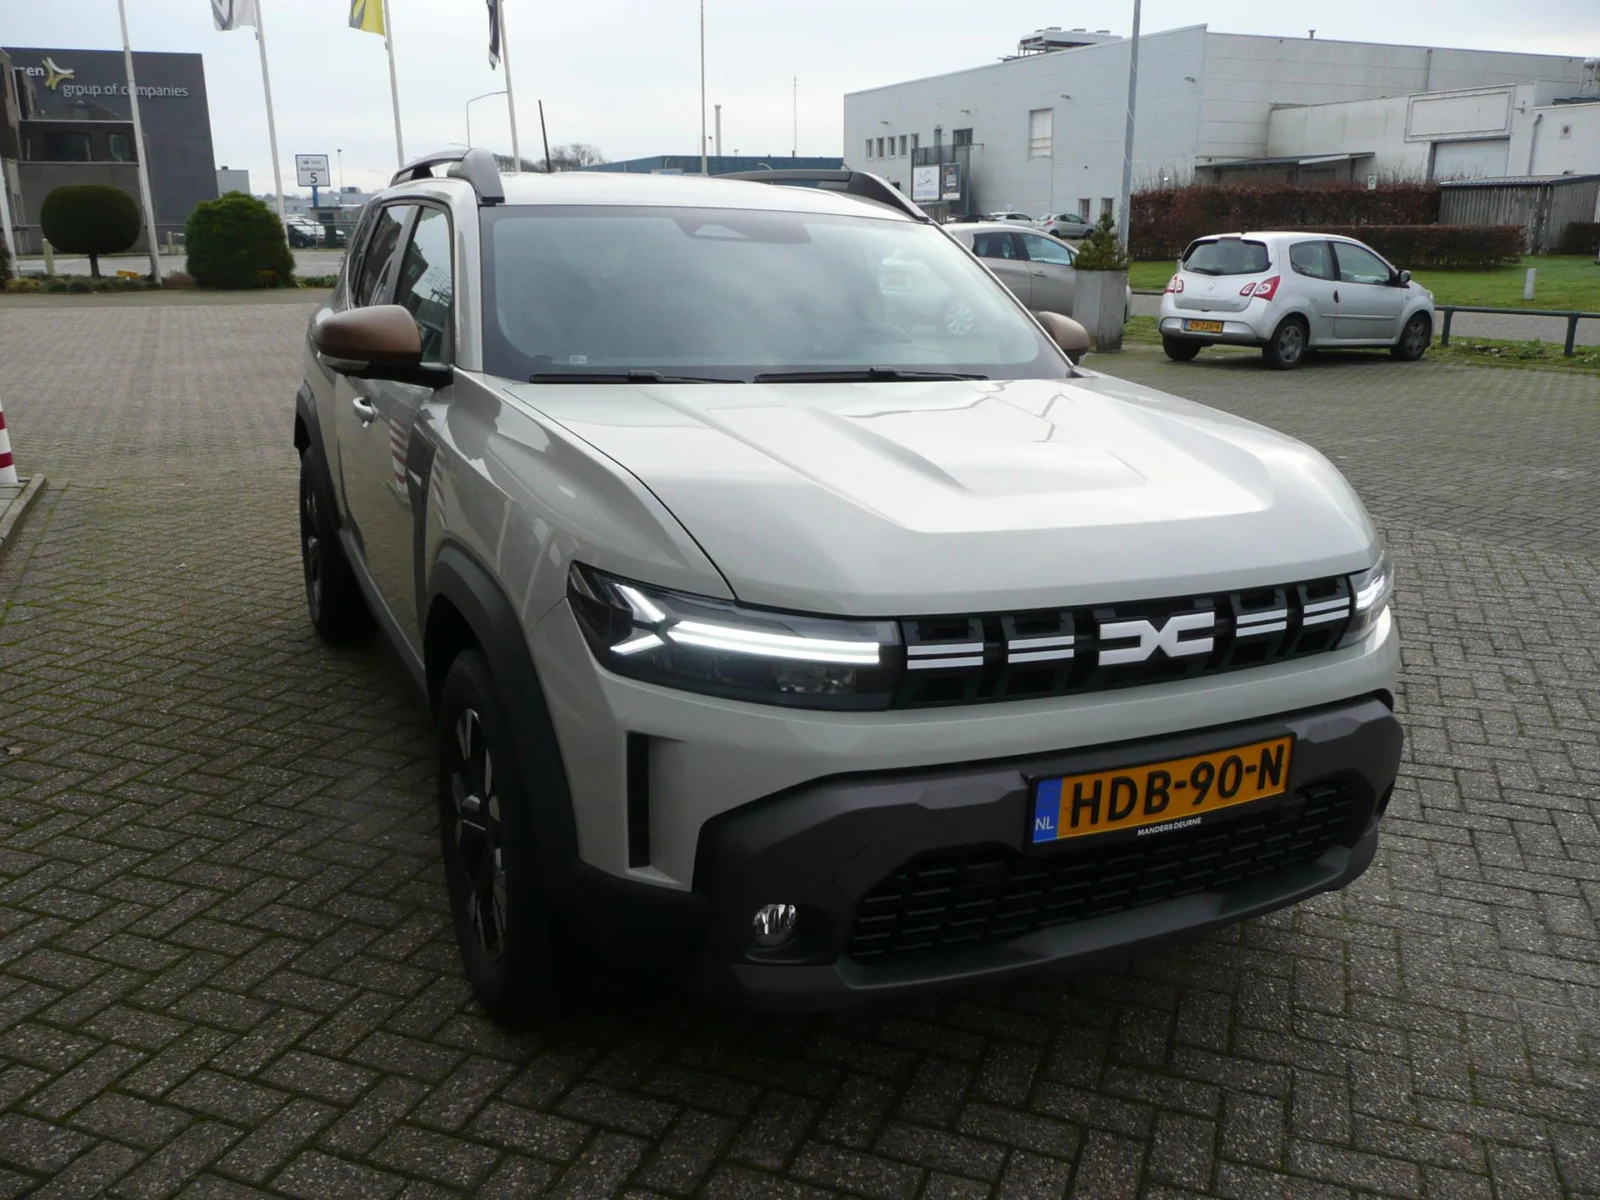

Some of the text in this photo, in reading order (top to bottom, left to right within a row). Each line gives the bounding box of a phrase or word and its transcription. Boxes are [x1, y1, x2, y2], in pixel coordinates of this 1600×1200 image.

[63, 83, 188, 99] group of cmpanies
[310, 172, 318, 184] 5
[1070, 744, 1285, 828] HDB-90-N
[1034, 816, 1055, 831] NL
[1137, 817, 1202, 837] MANDERS DEURNE
